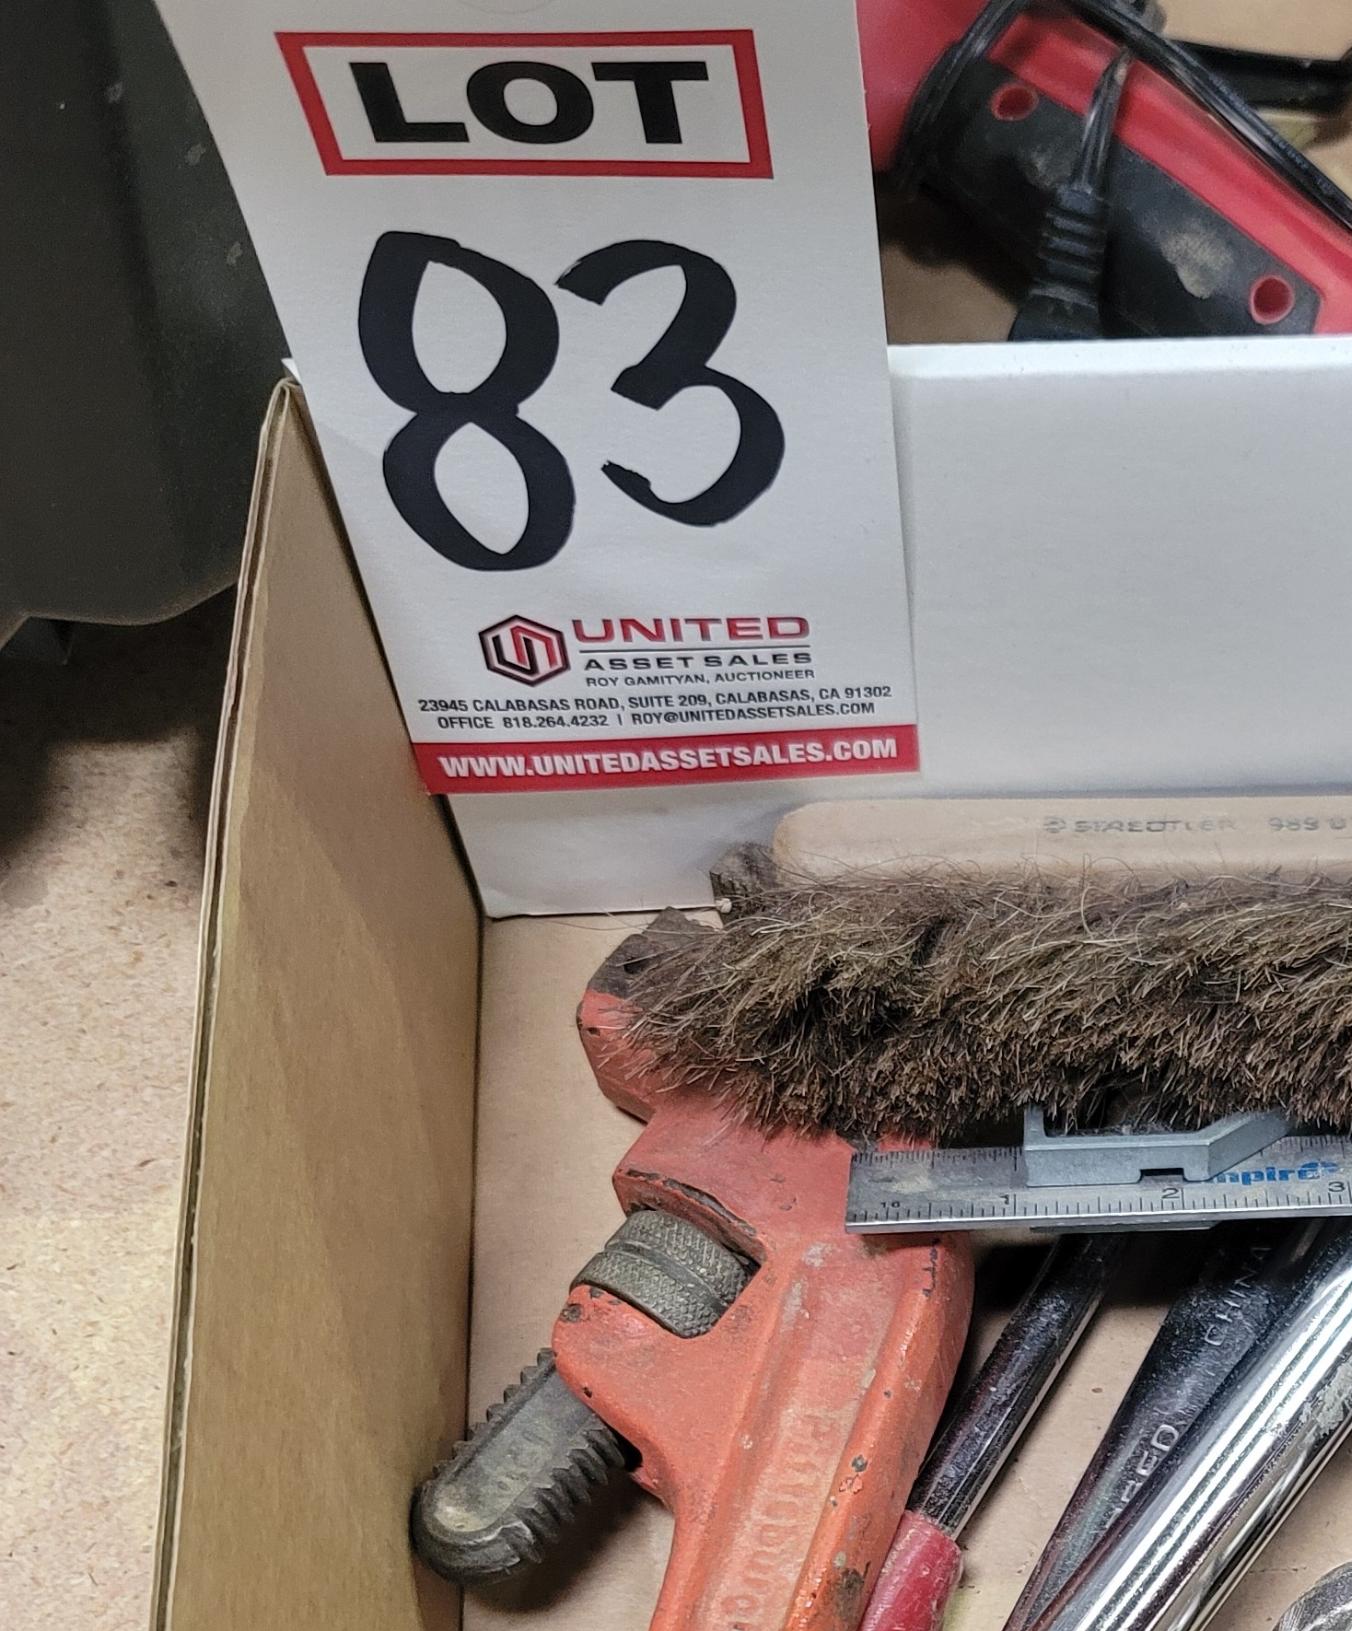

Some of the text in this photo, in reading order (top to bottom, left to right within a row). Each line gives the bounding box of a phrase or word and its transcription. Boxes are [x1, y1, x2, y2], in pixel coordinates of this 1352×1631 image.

[348, 60, 709, 145] LOT
[358, 230, 786, 572] 83
[571, 616, 810, 643] UNITED
[584, 652, 813, 671] ASSET SALES
[586, 669, 815, 687] ROY GAMITYAN, AUCTIONEER
[419, 685, 892, 712] 23945 CALABASAS ROAD, SUITE 209, CALABASAS, CA 91302
[437, 716, 495, 729] OFFICE
[503, 715, 609, 729] 818.264.4232
[632, 702, 876, 726] ROY@UNITEDASSETSALES.COM
[437, 738, 897, 778] WWW.UNITEDASSETSALES.COM
[1161, 1187, 1180, 1200] 2
[1327, 1180, 1345, 1193] 3
